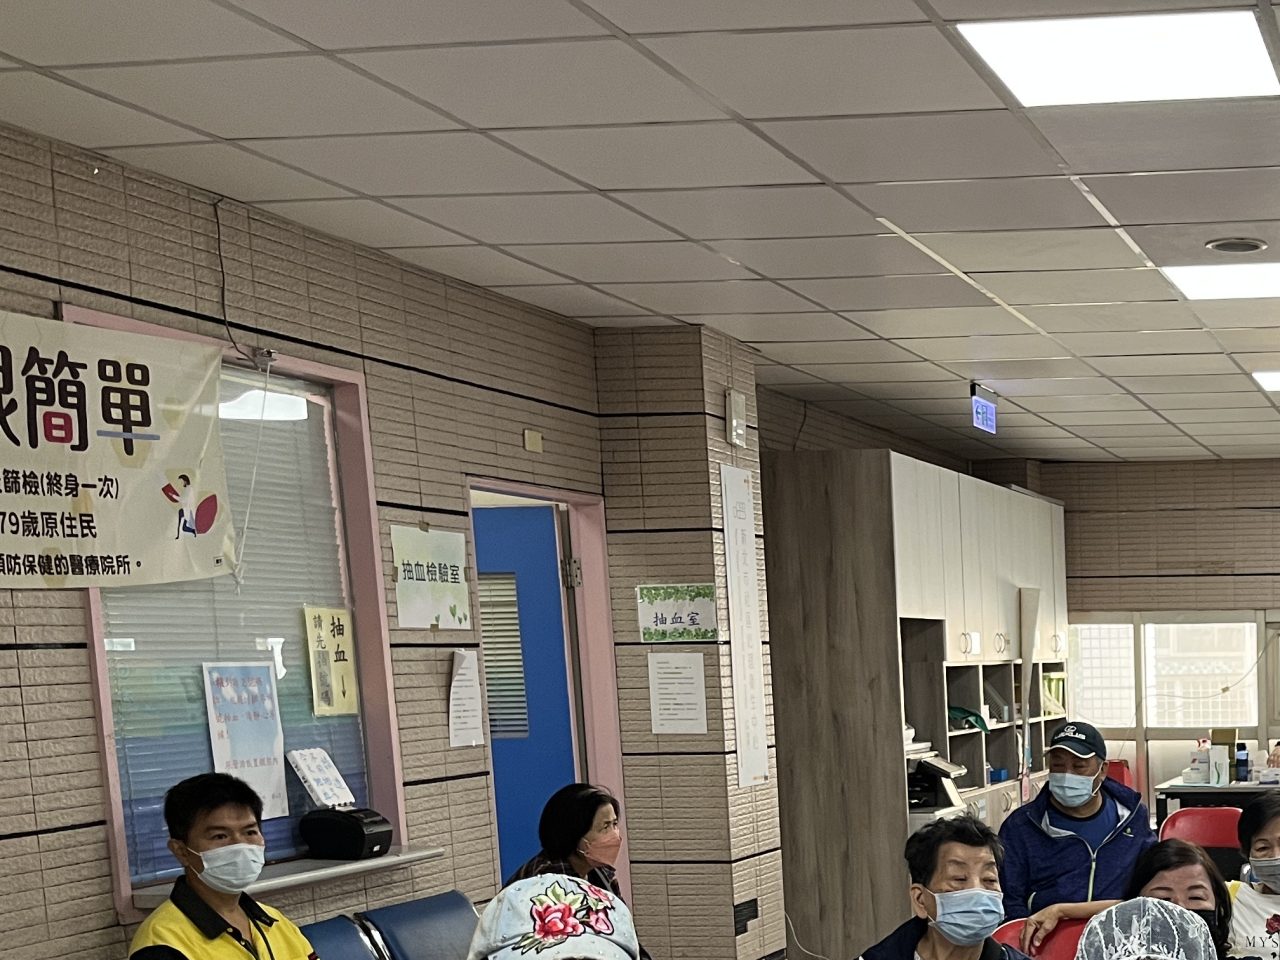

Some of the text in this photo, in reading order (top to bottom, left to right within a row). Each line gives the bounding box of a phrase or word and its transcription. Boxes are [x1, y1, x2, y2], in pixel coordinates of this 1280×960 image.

[0, 468, 118, 499] 篩檢(終身一次)
[402, 560, 460, 584] 抽血檢驗室
[653, 612, 701, 626] 抽血室
[330, 616, 348, 663] 抽血
